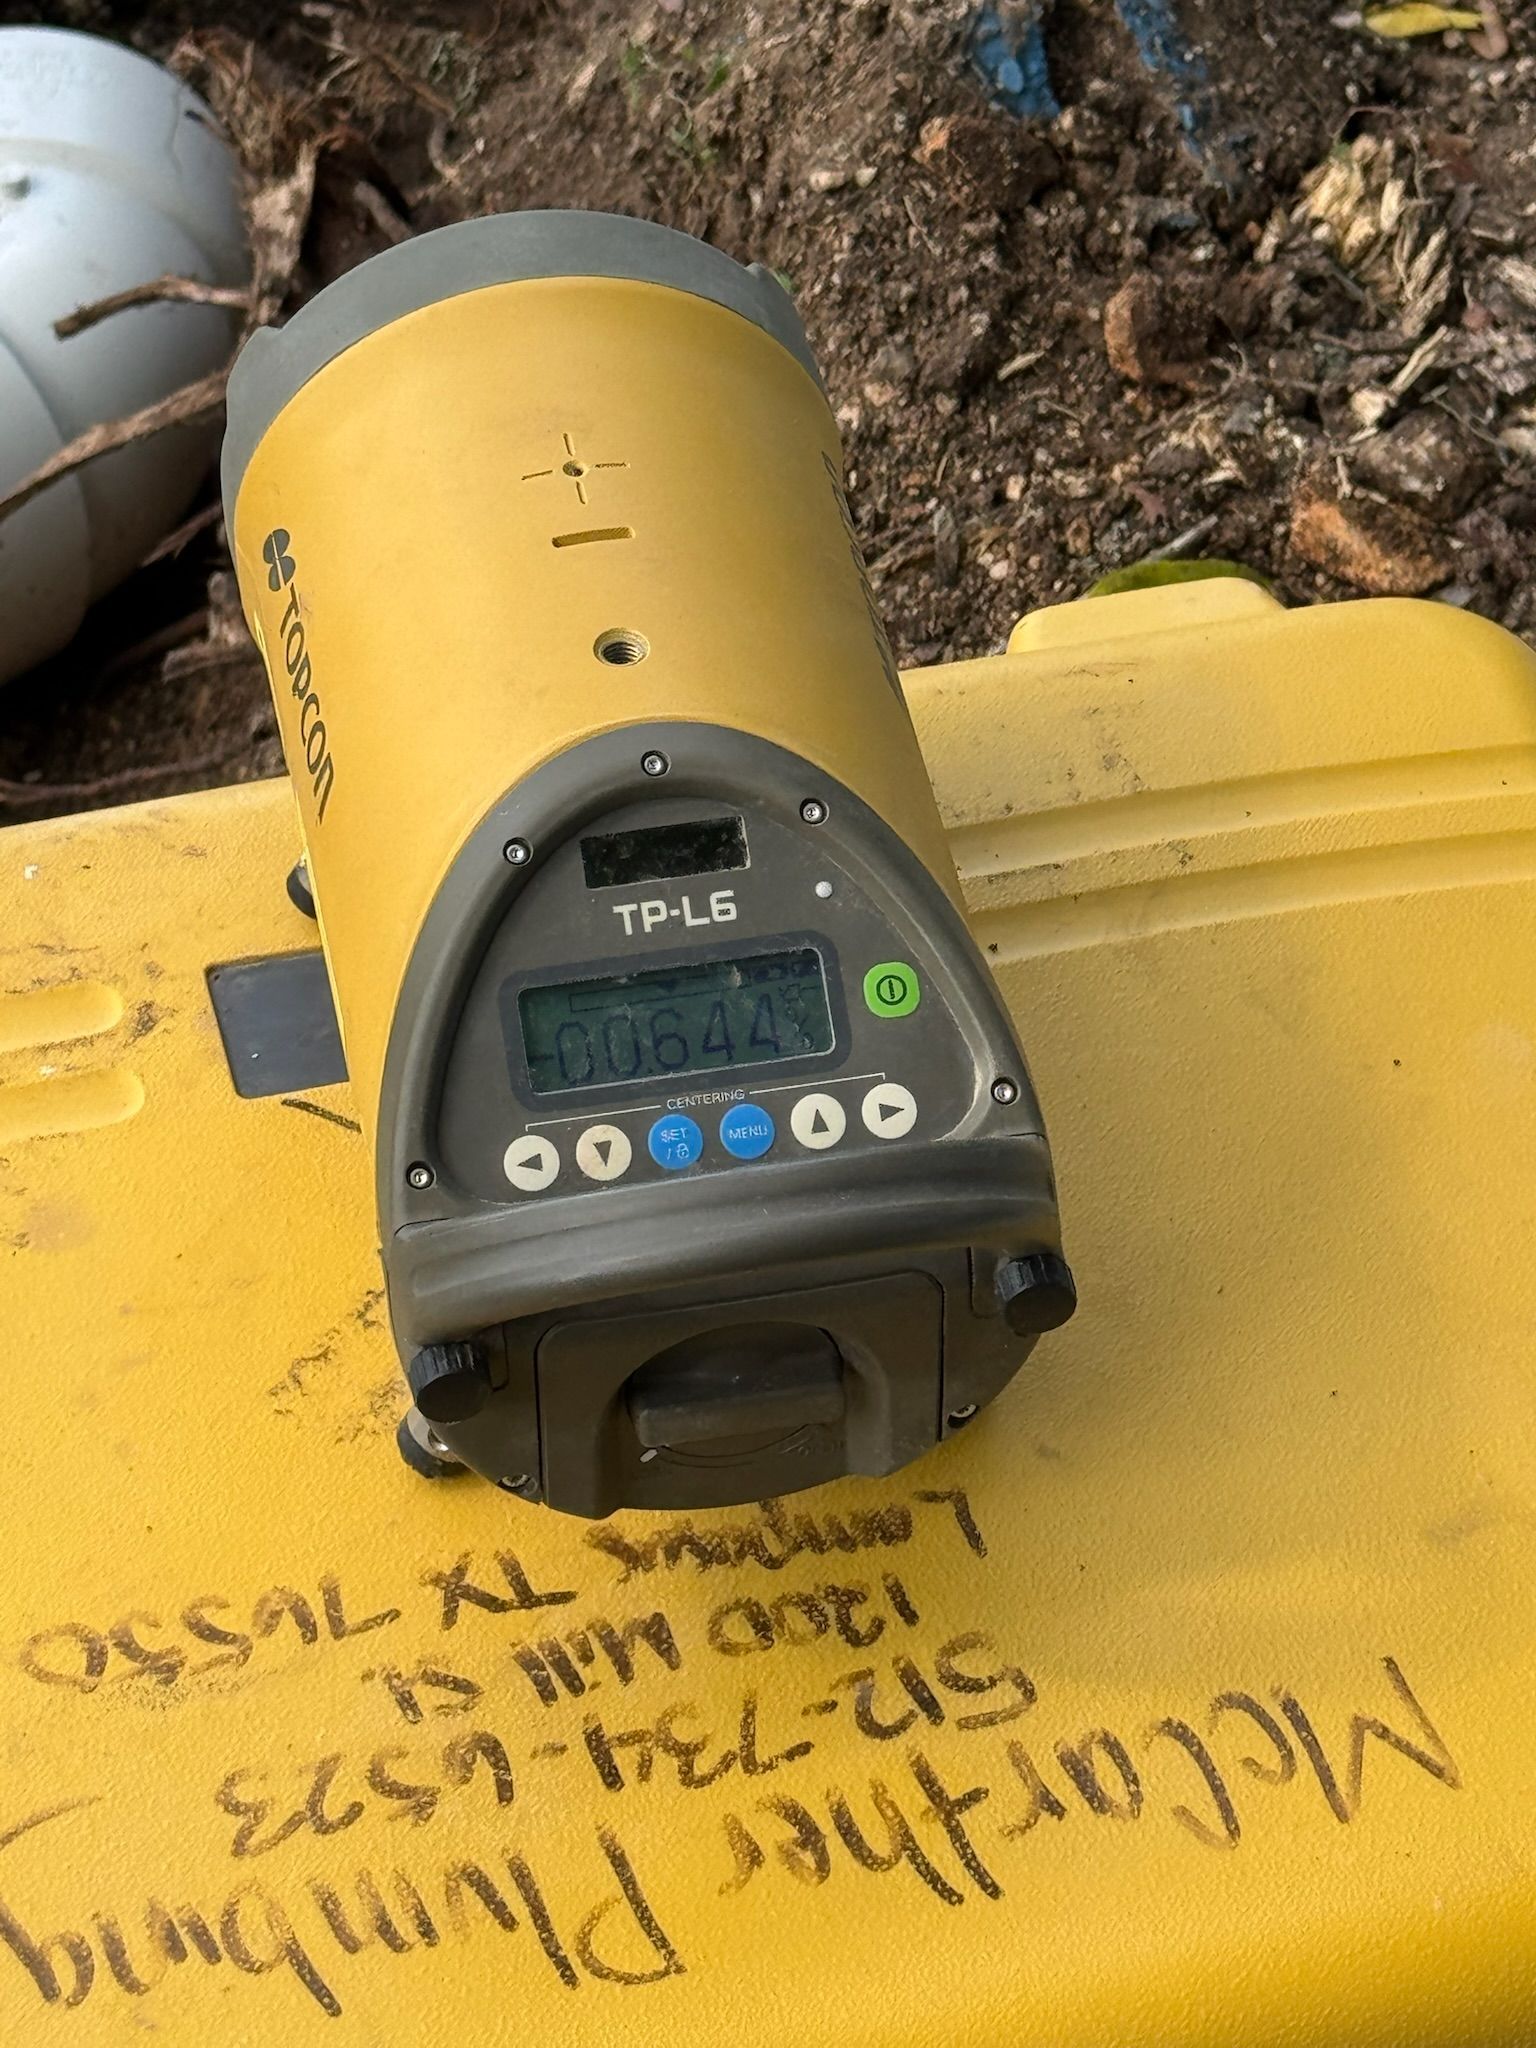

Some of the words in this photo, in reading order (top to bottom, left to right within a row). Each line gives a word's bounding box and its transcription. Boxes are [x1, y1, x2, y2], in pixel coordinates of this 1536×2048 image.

[279, 582, 334, 826] TOPCON
[612, 890, 738, 936] TP-L6
[660, 1127, 688, 1143] SET
[666, 1088, 745, 1110] CENTERING
[728, 1124, 769, 1140] MENU
[420, 1547, 578, 1631] TX
[707, 1572, 920, 1658] 1200
[18, 1570, 402, 1696] 76550
[512, 1610, 682, 1705] Mill
[213, 1630, 1037, 1858] 512-734-6523
[718, 1656, 1462, 1905] McCarther
